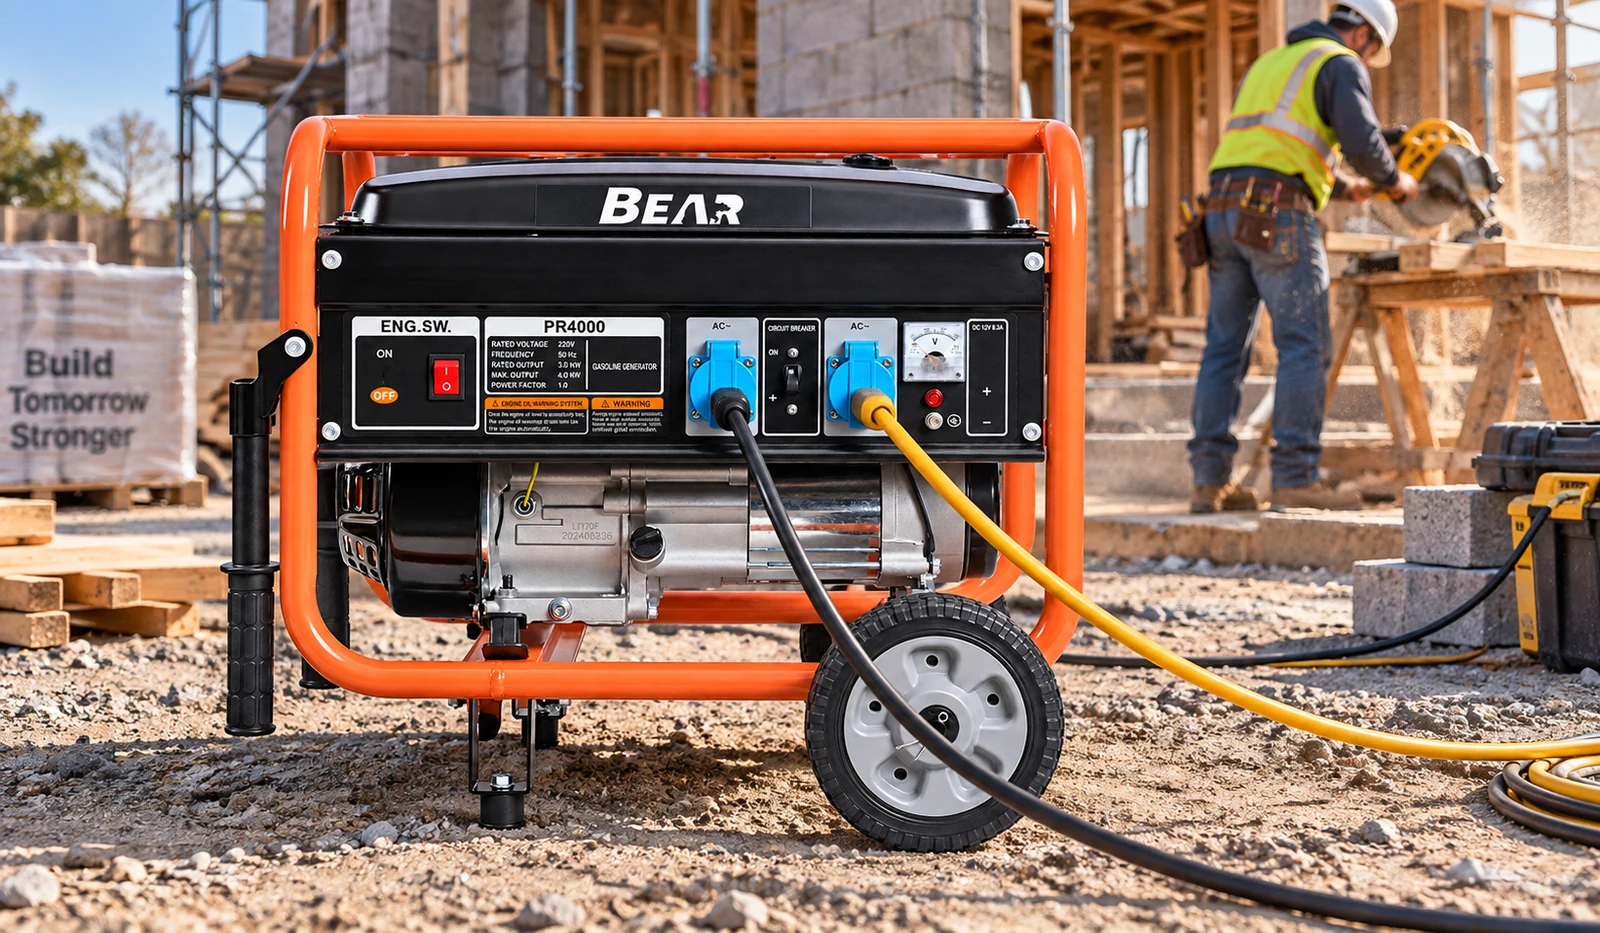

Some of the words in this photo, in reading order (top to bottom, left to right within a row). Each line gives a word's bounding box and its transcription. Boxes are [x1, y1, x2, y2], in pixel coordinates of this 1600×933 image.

[599, 187, 744, 225] BEAR
[381, 320, 452, 333] ENG.SW.
[544, 320, 606, 334] PR4000
[491, 340, 515, 348] RATED
[516, 340, 549, 348] VOLTAGE
[557, 340, 575, 348] 220V
[931, 337, 938, 346] V
[376, 348, 393, 359] ON
[491, 351, 535, 359] FREQUENCY
[768, 348, 779, 356] ON
[25, 348, 115, 378] Build
[491, 361, 515, 369] RATED
[516, 361, 544, 369] OUTPUT
[557, 361, 568, 369] 3.0
[569, 361, 582, 369] KW
[591, 362, 622, 371] GASOLINE
[622, 362, 658, 371] GENERATOR
[491, 371, 509, 379] MAX.
[510, 371, 539, 379] OUTPUT
[557, 371, 568, 379] 4.0
[491, 381, 517, 389] POWER
[518, 381, 547, 389] FACTOR
[8, 386, 151, 413] Tomorrow
[373, 391, 396, 401] OFF
[613, 400, 651, 408] WARNING
[10, 422, 135, 455] Stronger
